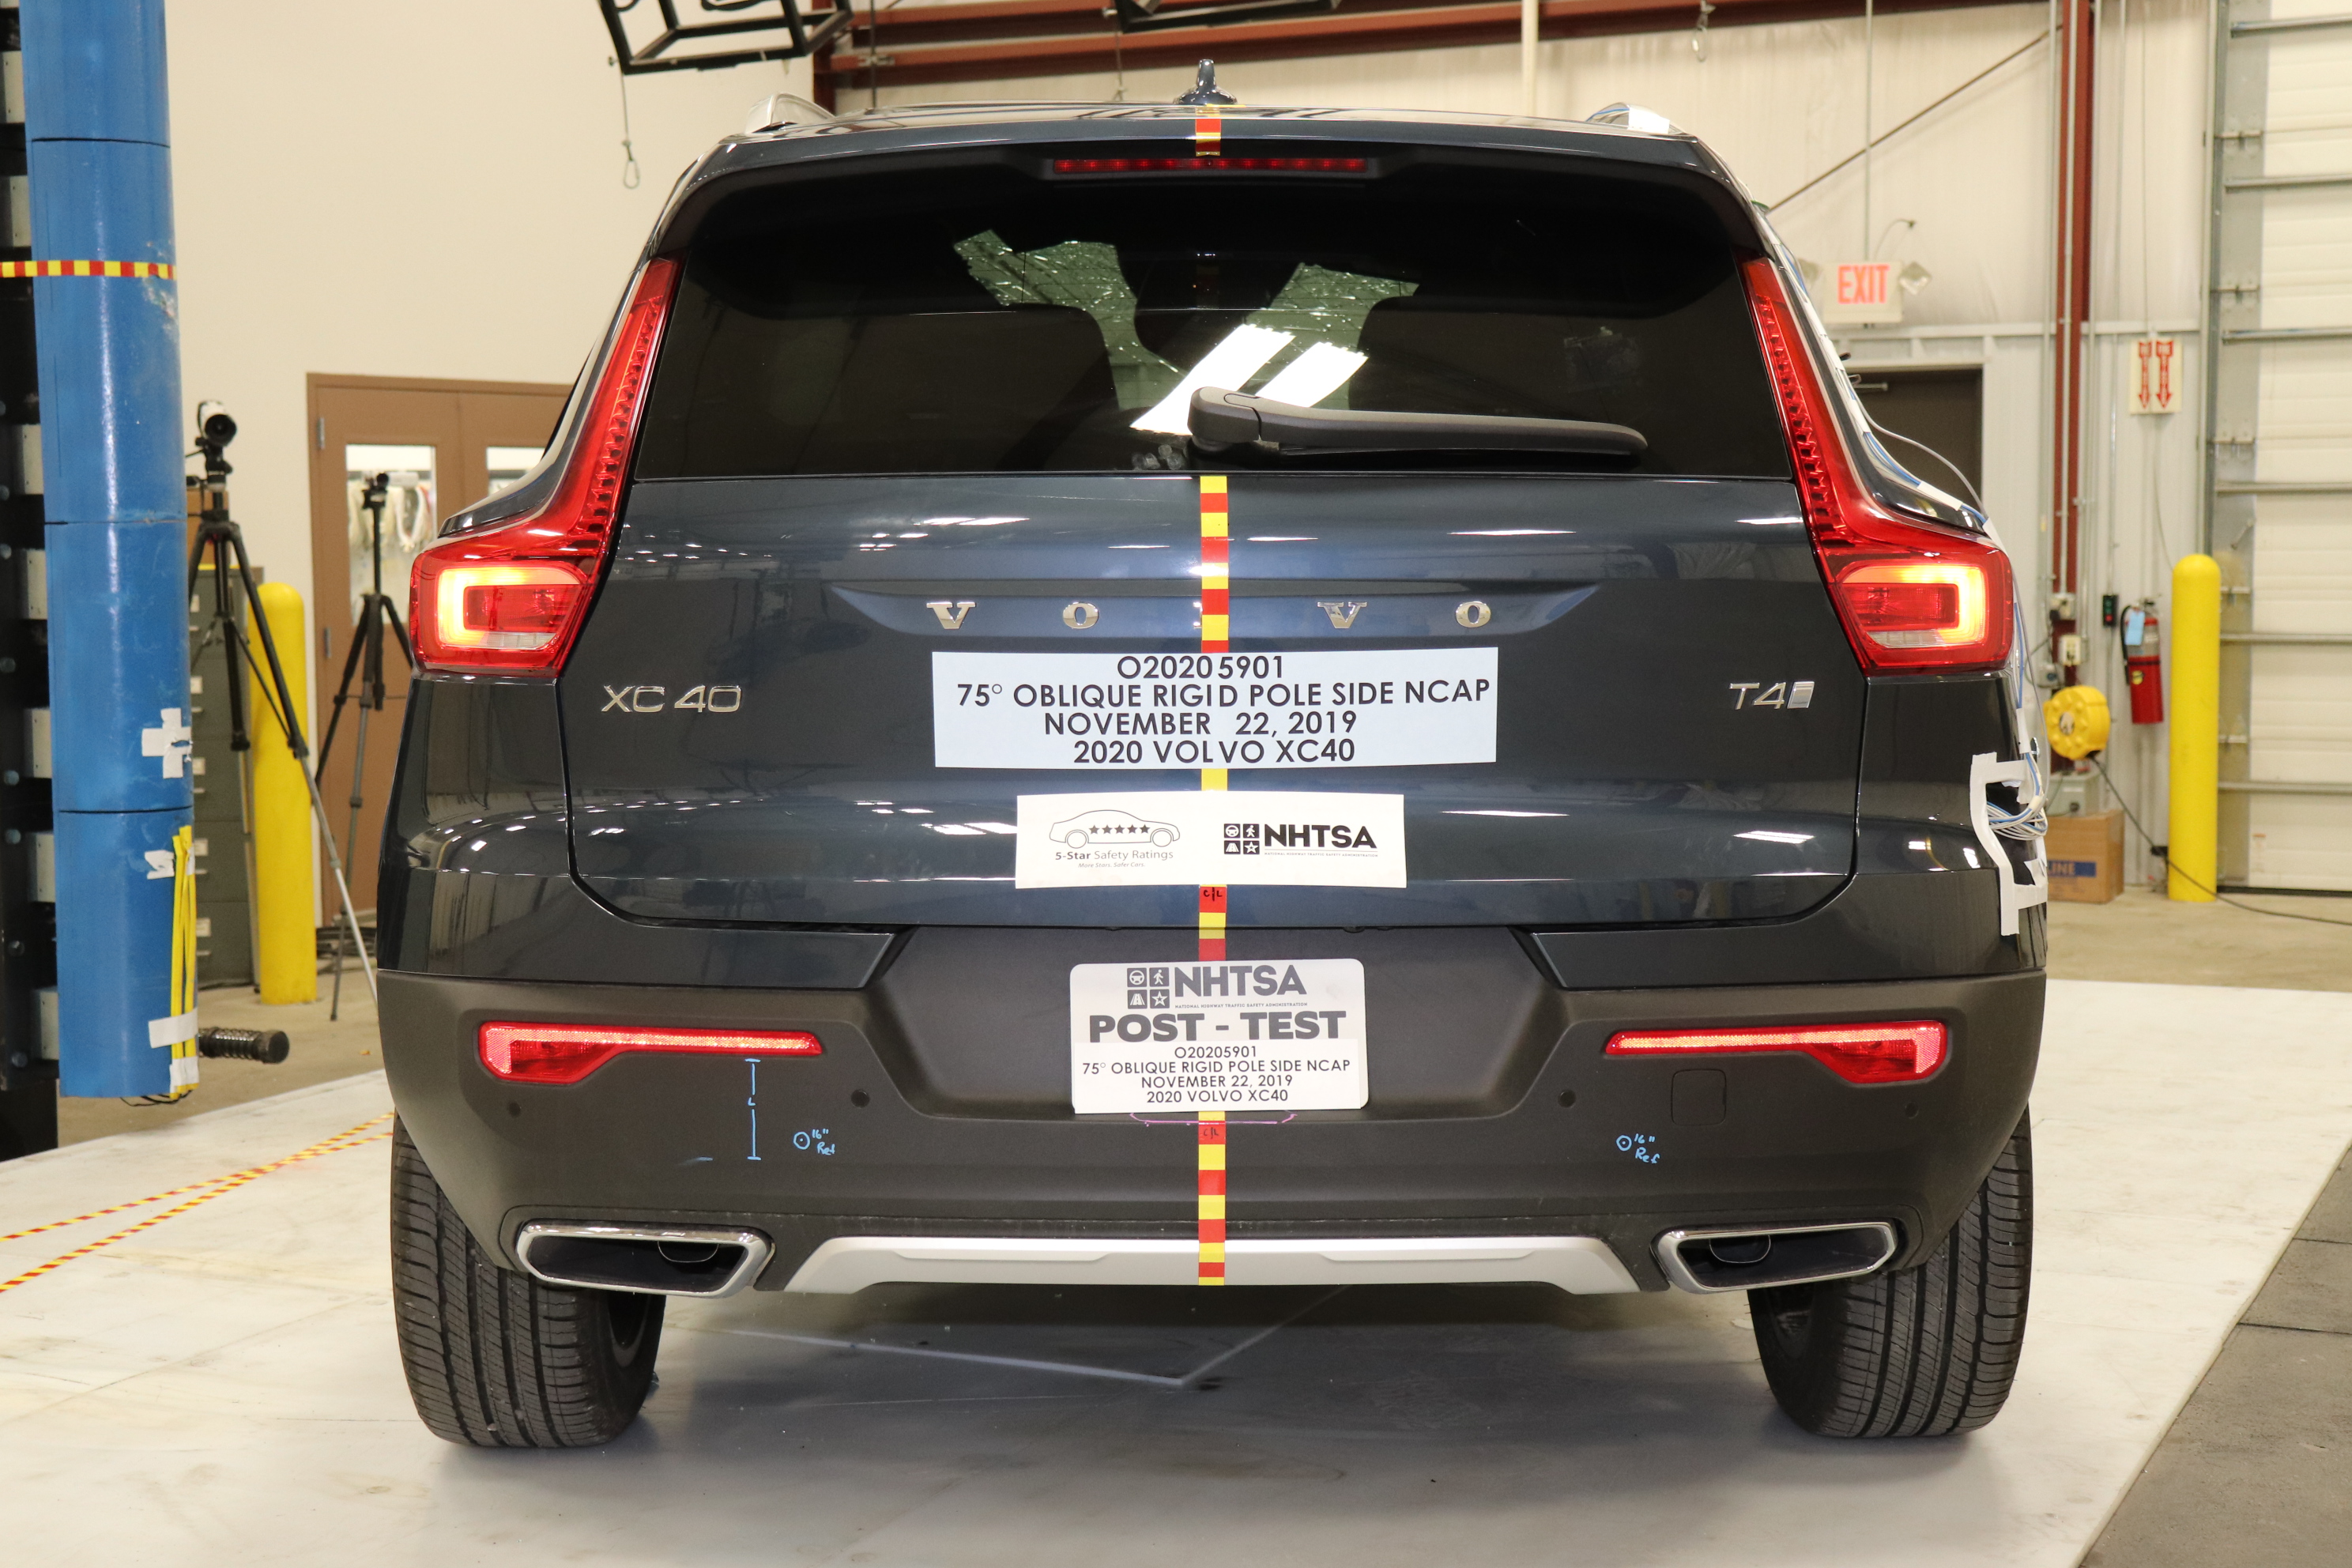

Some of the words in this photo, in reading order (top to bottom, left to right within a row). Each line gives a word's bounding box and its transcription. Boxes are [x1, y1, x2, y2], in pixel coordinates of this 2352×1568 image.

[1838, 263, 1890, 304] EXIT
[926, 601, 1492, 630] VOVO
[957, 684, 1002, 707] 75°
[1013, 684, 1141, 708] OBLIQUE
[1153, 683, 1238, 707] RIGID
[1250, 683, 1321, 707] POLE
[1332, 682, 1393, 706] SIDE
[1405, 679, 1490, 703] NCAP
[1045, 712, 1212, 736] NOVEMBER
[1235, 712, 1277, 738] 22,
[1287, 710, 1357, 734] 2019
[1073, 740, 1143, 764] 2020
[1153, 739, 1265, 764] VOLVO
[1276, 738, 1355, 763] XC40
[1265, 824, 1377, 848] NHTSA
[1055, 851, 1091, 860] 5-Star
[1094, 850, 1129, 861] Safety
[1132, 850, 1174, 861] Ratings
[1174, 965, 1306, 997] NHTSA
[1090, 1013, 1204, 1043] POST
[1240, 1010, 1347, 1040] TEST
[1111, 1061, 1176, 1075] OBLIQUE
[1182, 1061, 1223, 1073] RIGID
[1229, 1060, 1265, 1072] POLE
[1271, 1059, 1302, 1072] SIDE
[1307, 1059, 1351, 1072] NCAP
[1142, 1076, 1226, 1088] NOVEMBER
[1231, 1075, 1253, 1088] 22,
[1258, 1074, 1293, 1087] 2019
[1147, 1090, 1182, 1103] 2020
[1187, 1089, 1242, 1102] VOLVO
[1248, 1088, 1288, 1102] XC40
[1634, 1147, 1660, 1164] Ref
